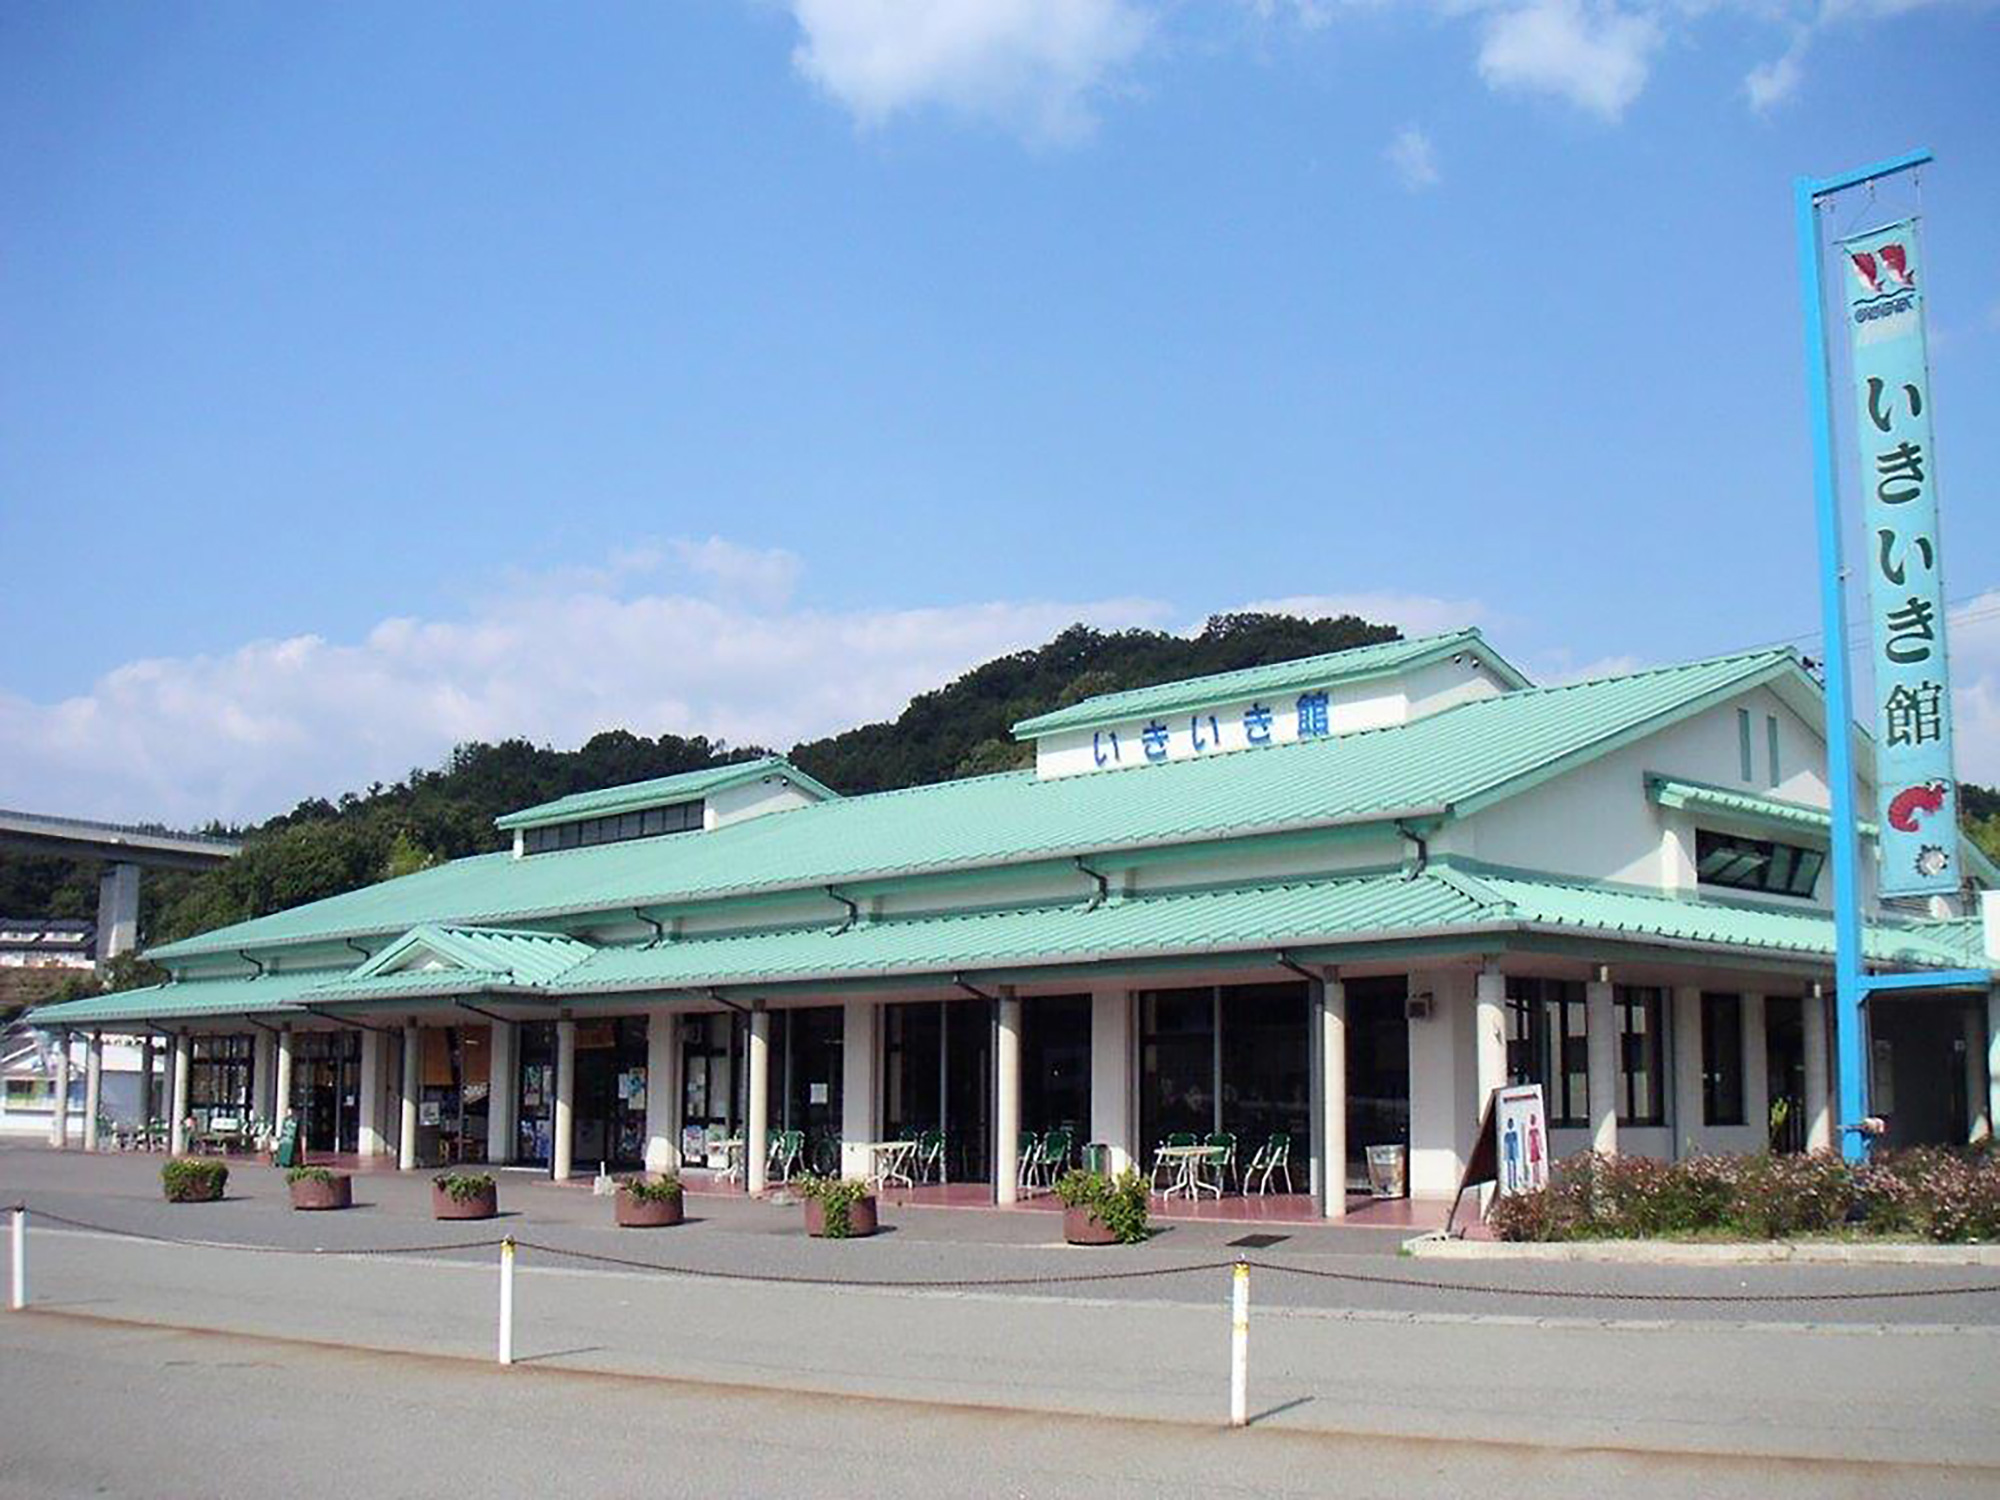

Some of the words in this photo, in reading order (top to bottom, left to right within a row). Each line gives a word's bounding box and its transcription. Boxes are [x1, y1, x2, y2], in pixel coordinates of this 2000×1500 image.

[1867, 377, 1942, 747] いきいき館
[1093, 691, 1329, 765] いきいき館
